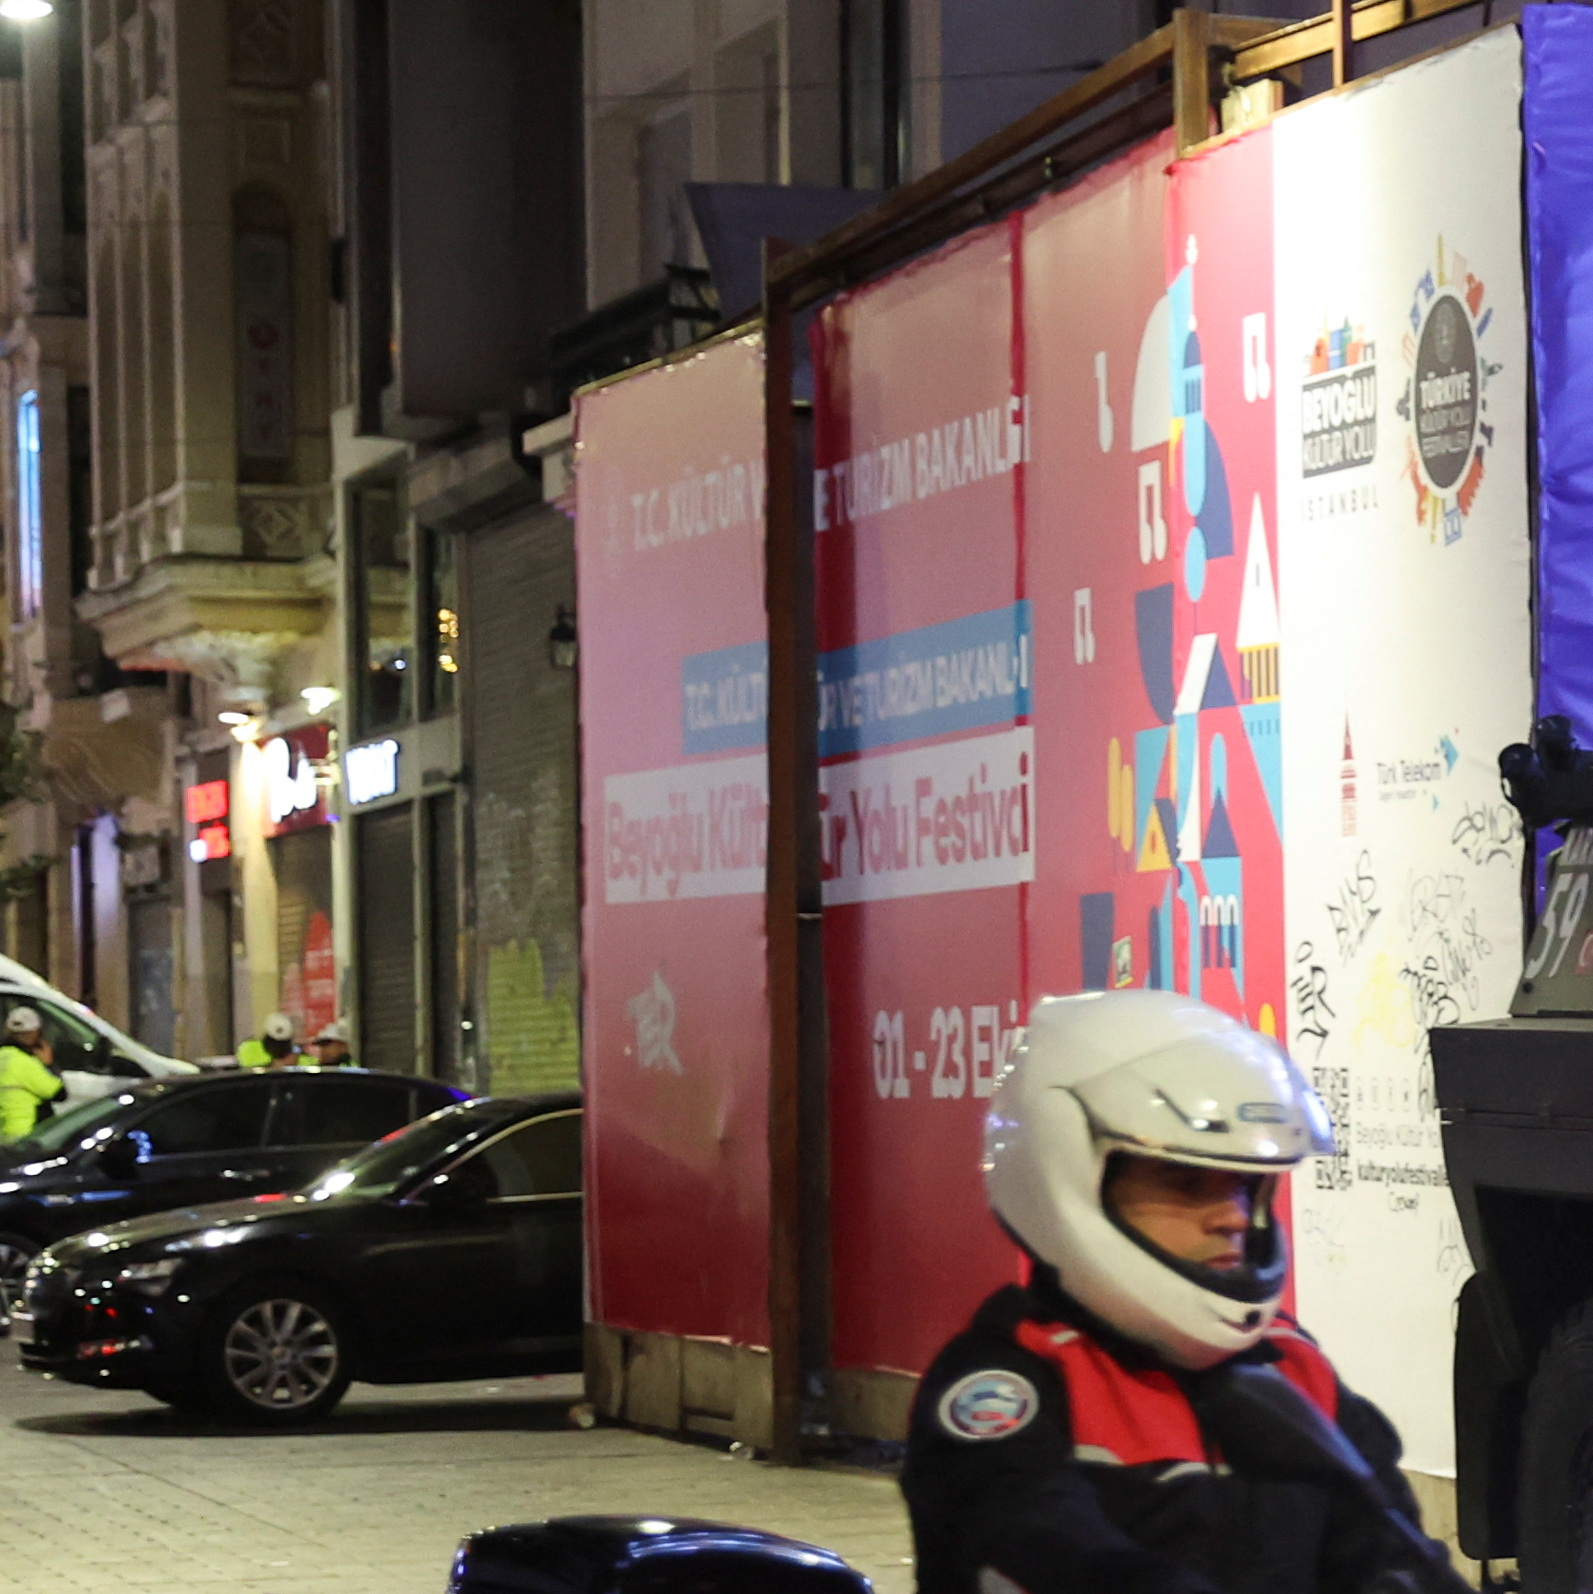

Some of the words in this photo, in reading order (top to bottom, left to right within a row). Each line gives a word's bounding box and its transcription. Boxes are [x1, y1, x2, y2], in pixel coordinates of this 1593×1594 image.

[668, 455, 746, 541] KÜLTÜR
[1400, 757, 1441, 782] Telekom
[606, 791, 703, 896] Beyoğlu
[849, 780, 910, 876] Yolu
[1524, 872, 1590, 979] 59
[872, 1010, 911, 1100] 01
[930, 1005, 967, 1100] 23
